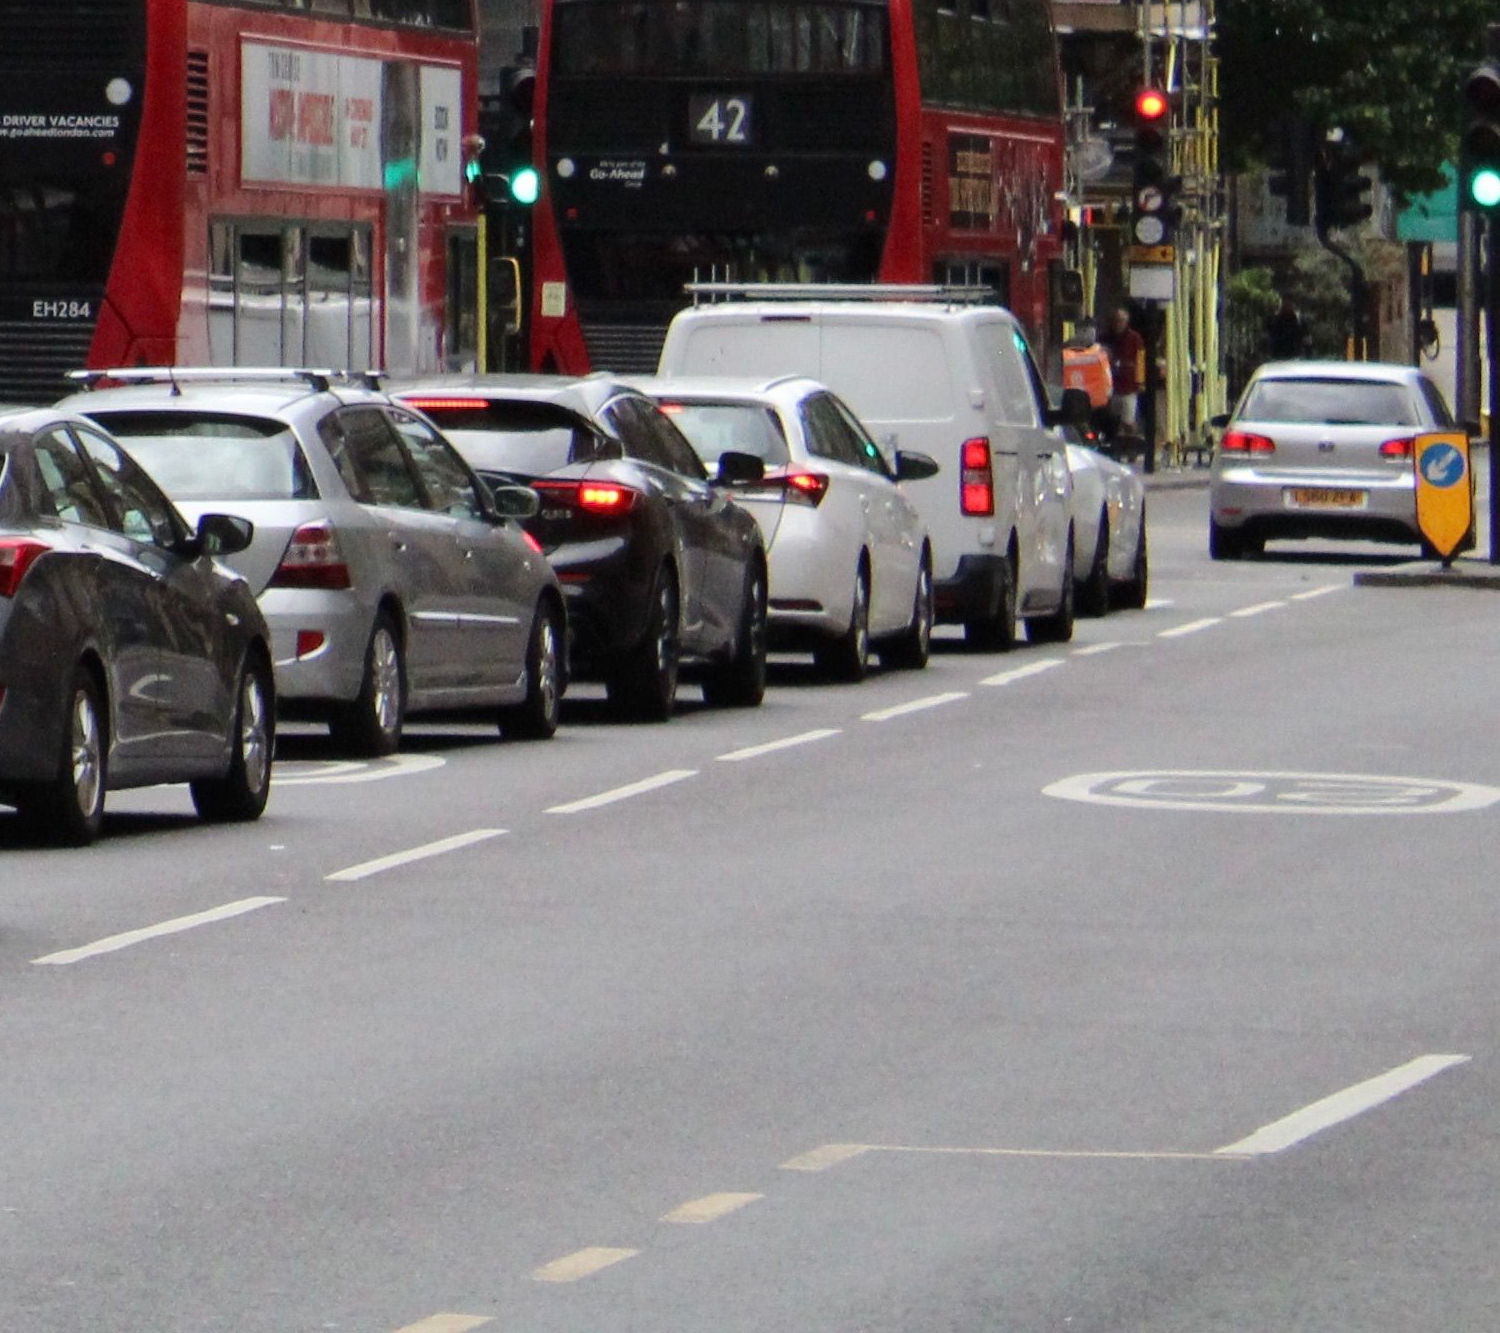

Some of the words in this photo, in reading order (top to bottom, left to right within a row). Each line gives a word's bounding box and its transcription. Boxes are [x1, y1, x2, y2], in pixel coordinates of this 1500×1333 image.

[3, 115, 46, 128] DRIVER
[49, 115, 120, 129] VACANCIES
[696, 99, 747, 141] 42
[589, 167, 645, 180] Go-Ahead
[33, 300, 91, 318] EH284
